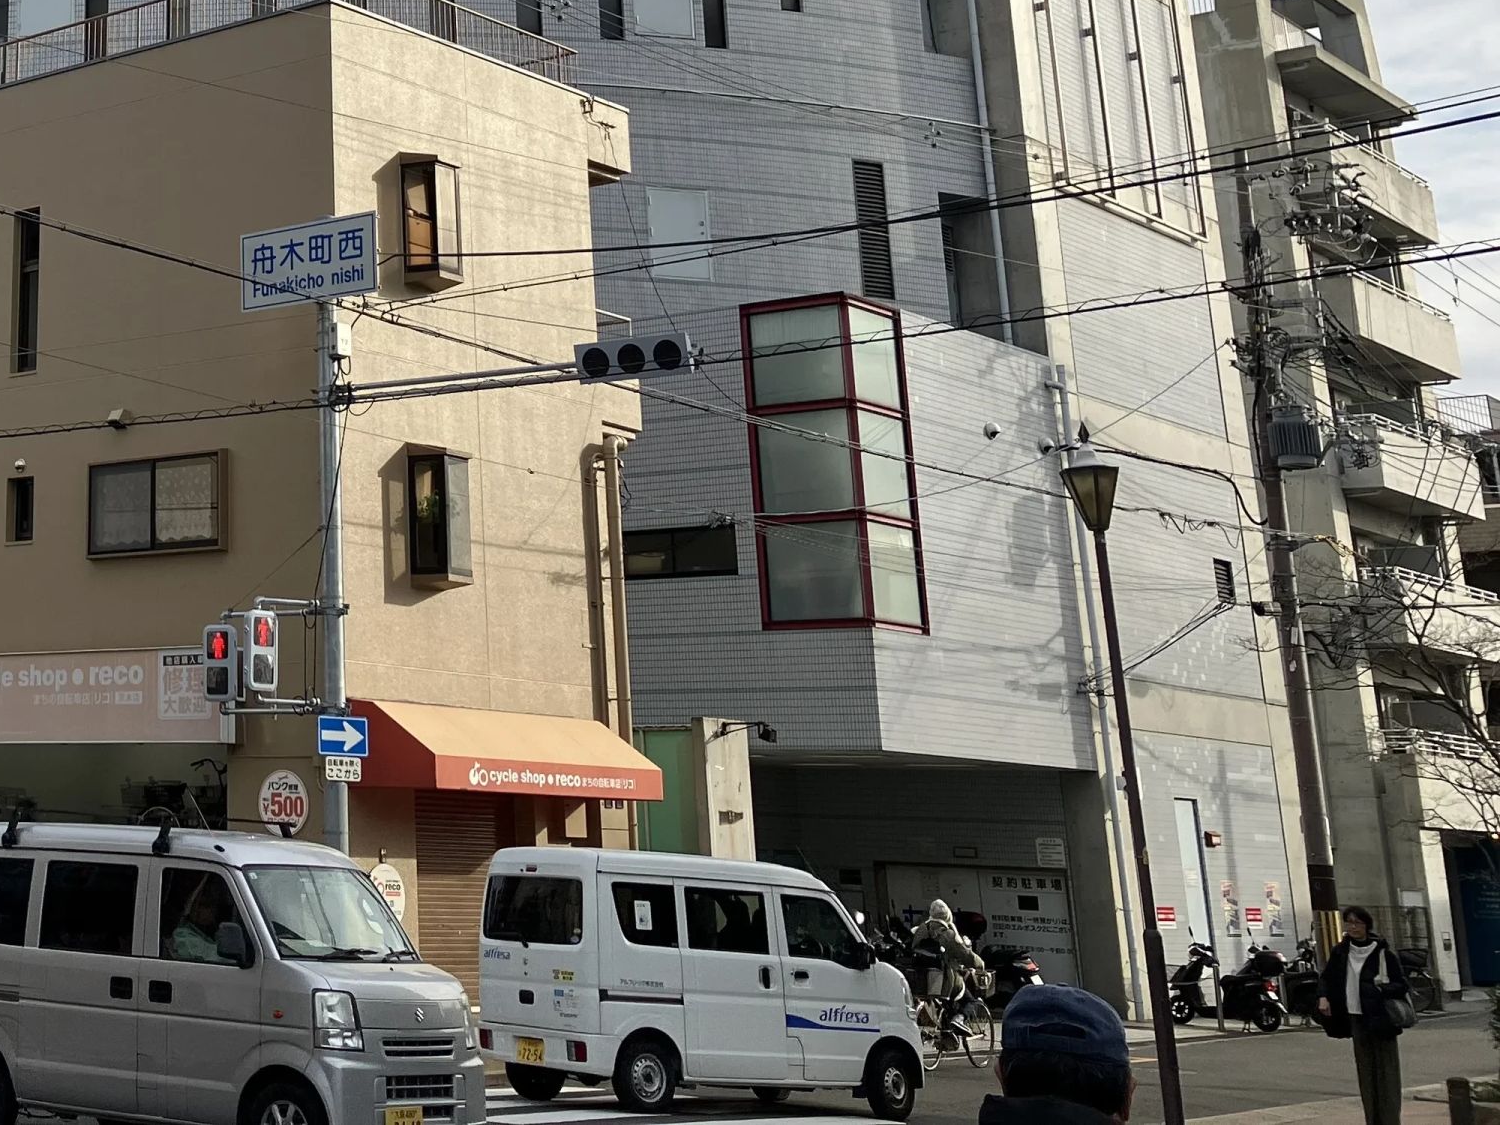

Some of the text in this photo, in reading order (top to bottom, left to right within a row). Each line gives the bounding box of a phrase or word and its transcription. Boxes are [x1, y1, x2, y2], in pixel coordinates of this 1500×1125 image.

[251, 228, 364, 275] 舟木町西
[253, 264, 364, 298] Funakicho nishi
[17, 664, 69, 692] shop
[89, 664, 143, 686] reco
[163, 696, 207, 714] 大歓迎
[327, 758, 359, 767] 自転車を除く
[327, 768, 360, 780] ここから
[490, 769, 581, 788] cycle shop reco
[991, 876, 1063, 891] 契約駐車場
[483, 947, 511, 961] alfresa
[819, 1004, 870, 1024] alfresa
